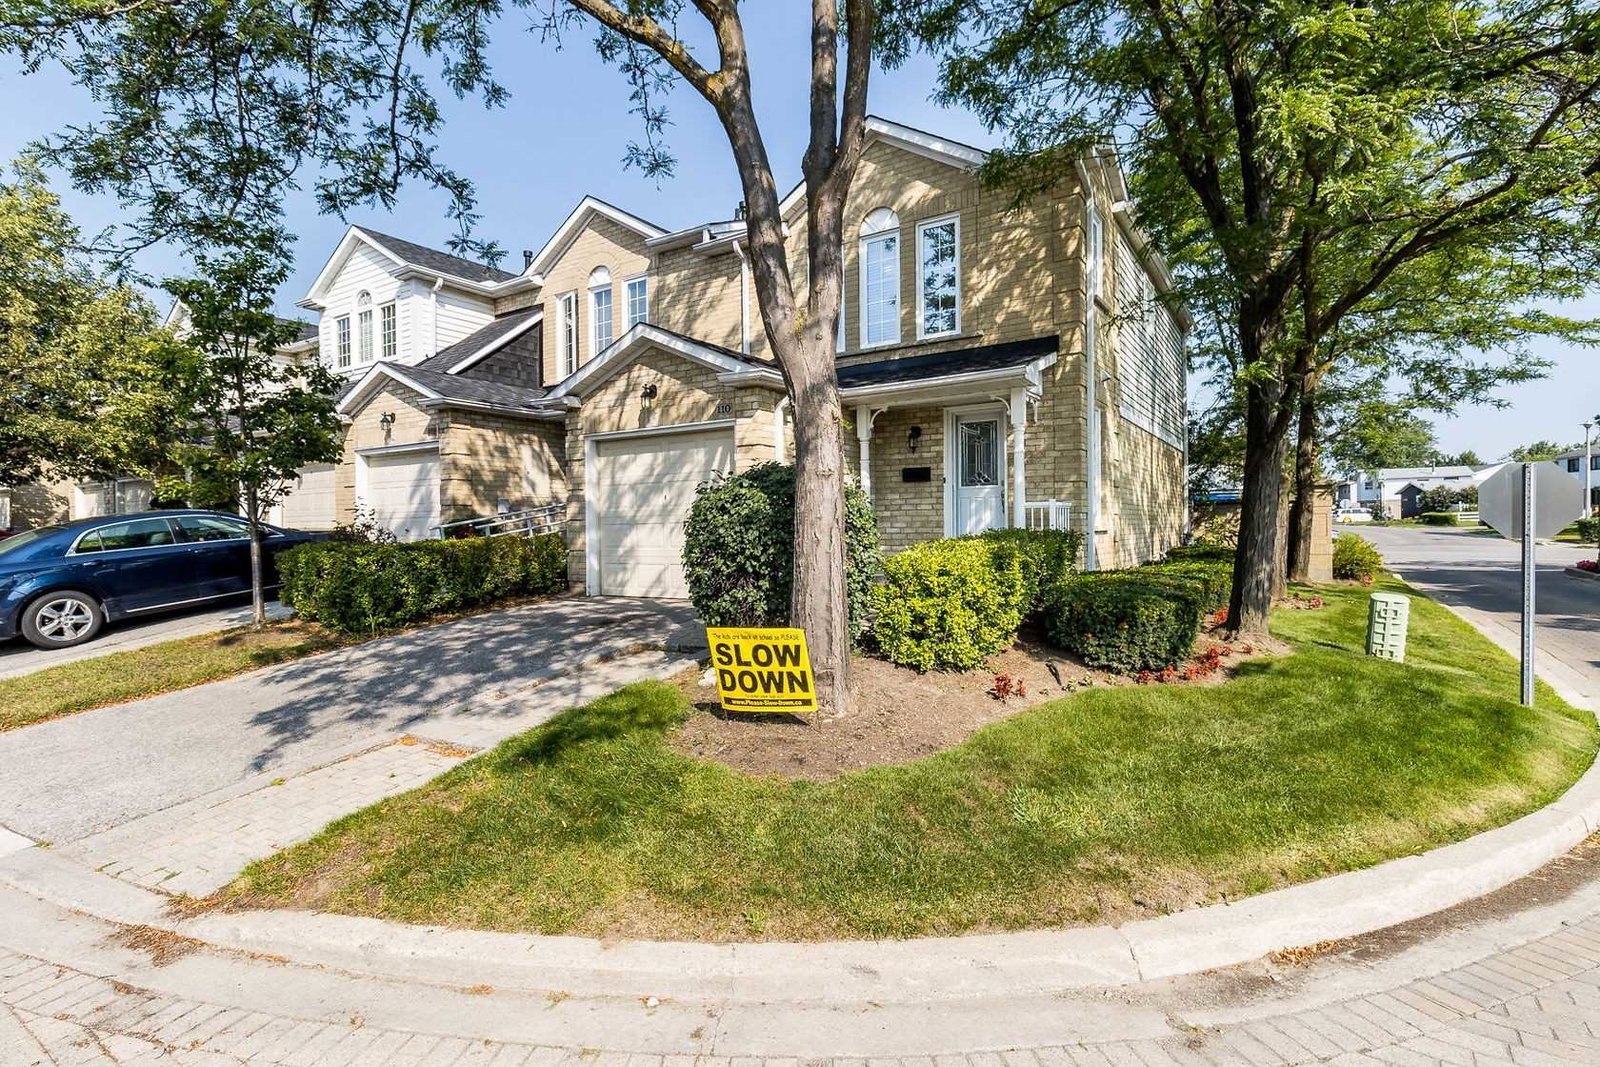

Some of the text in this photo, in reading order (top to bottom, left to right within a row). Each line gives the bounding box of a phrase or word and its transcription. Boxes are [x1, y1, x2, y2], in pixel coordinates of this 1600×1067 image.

[717, 404, 731, 413] 110
[781, 633, 800, 641] PLEASE
[715, 643, 801, 667] SLOW
[718, 669, 809, 693] DOWN
